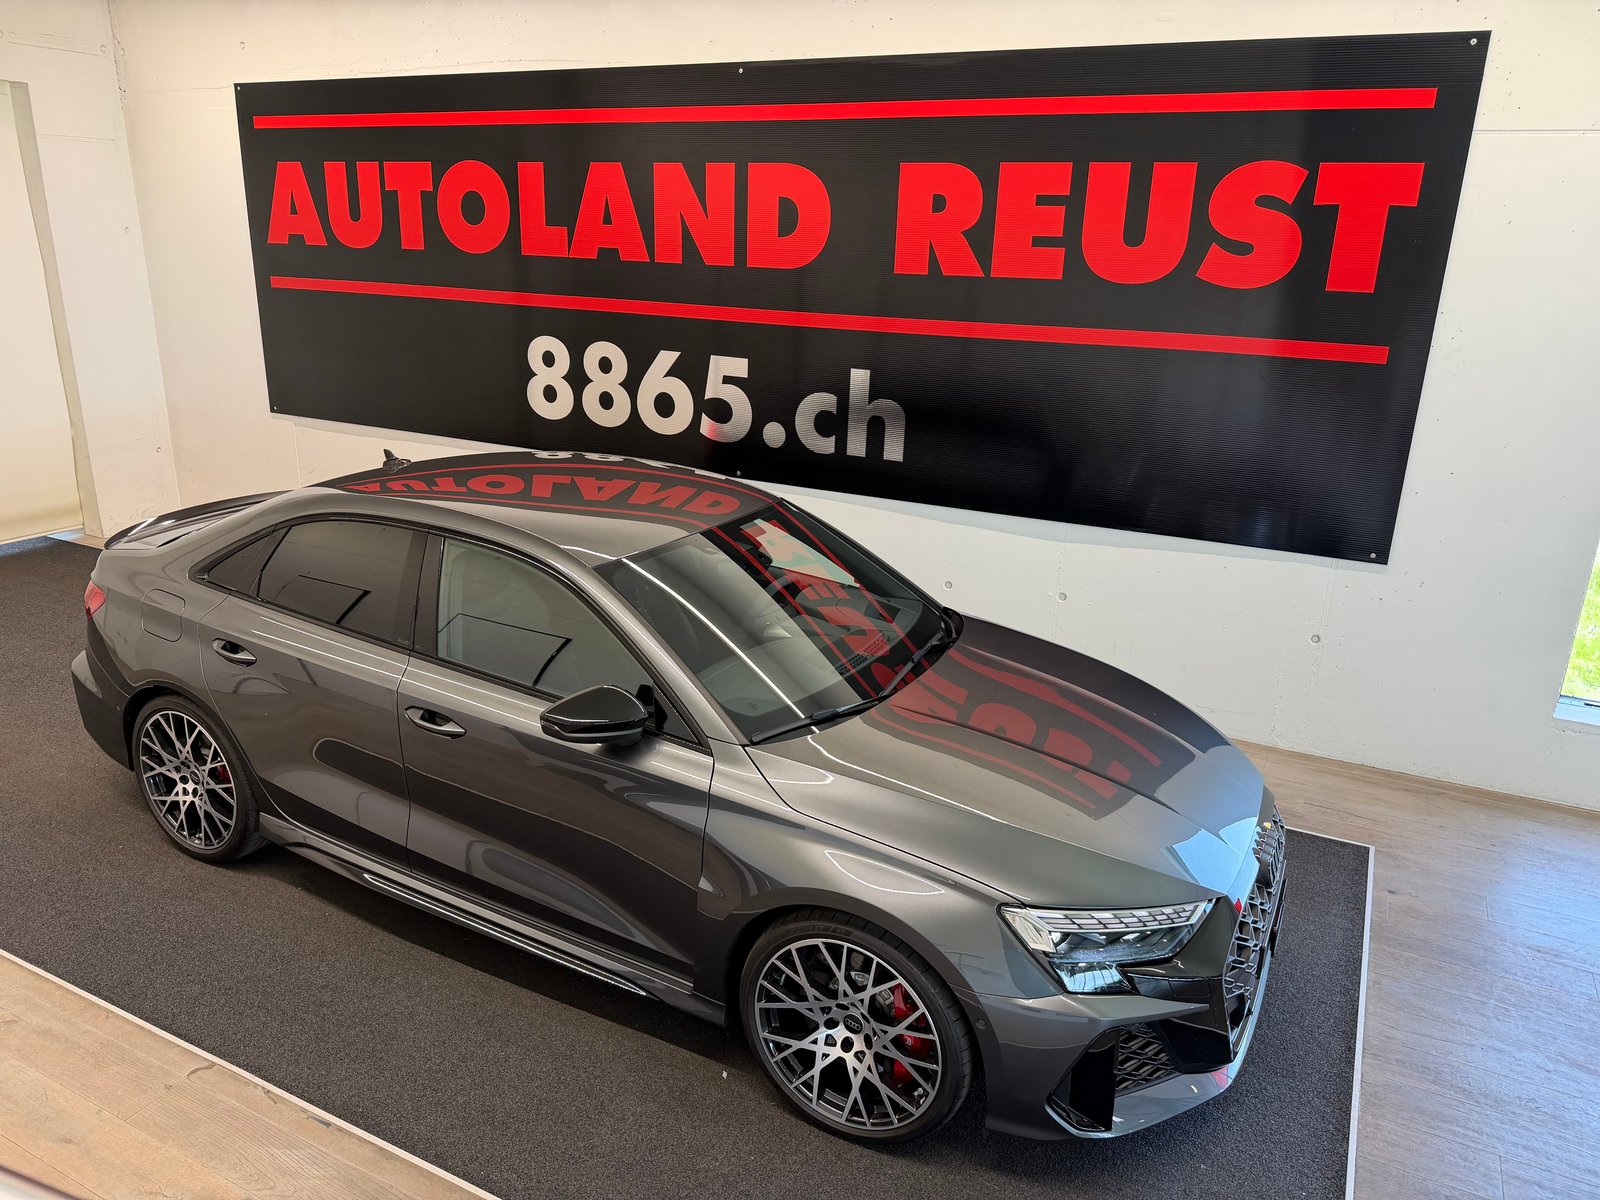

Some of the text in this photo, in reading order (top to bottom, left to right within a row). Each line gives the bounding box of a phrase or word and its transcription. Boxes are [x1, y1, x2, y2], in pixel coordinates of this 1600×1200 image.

[267, 159, 1425, 294] AUTOLAND REUST
[526, 335, 906, 464] 8865.ch
